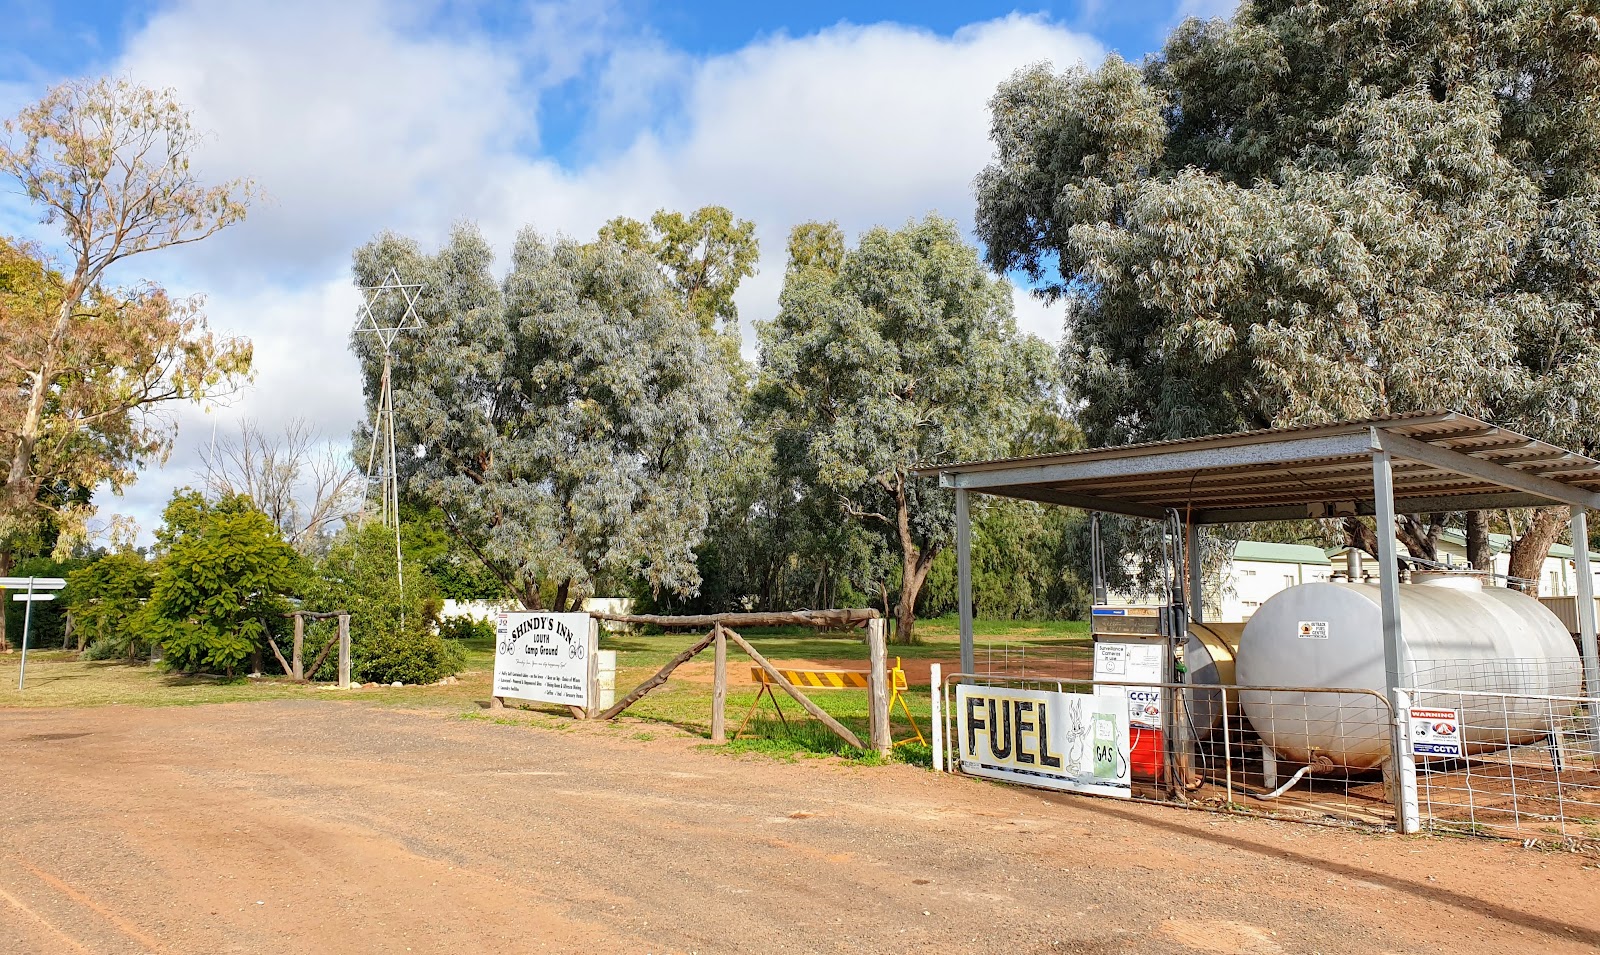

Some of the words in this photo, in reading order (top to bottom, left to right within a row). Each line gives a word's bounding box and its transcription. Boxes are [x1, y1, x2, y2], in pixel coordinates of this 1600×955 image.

[511, 616, 554, 643] SHINDY'S
[556, 620, 574, 645] INN
[533, 634, 550, 644] LOUTH
[525, 644, 538, 656] Camp
[540, 645, 558, 655] Ground
[1130, 692, 1158, 702] CCTV
[965, 696, 1062, 769] FUEL
[1096, 745, 1113, 763] GAS
[1433, 745, 1458, 754] CCTV
